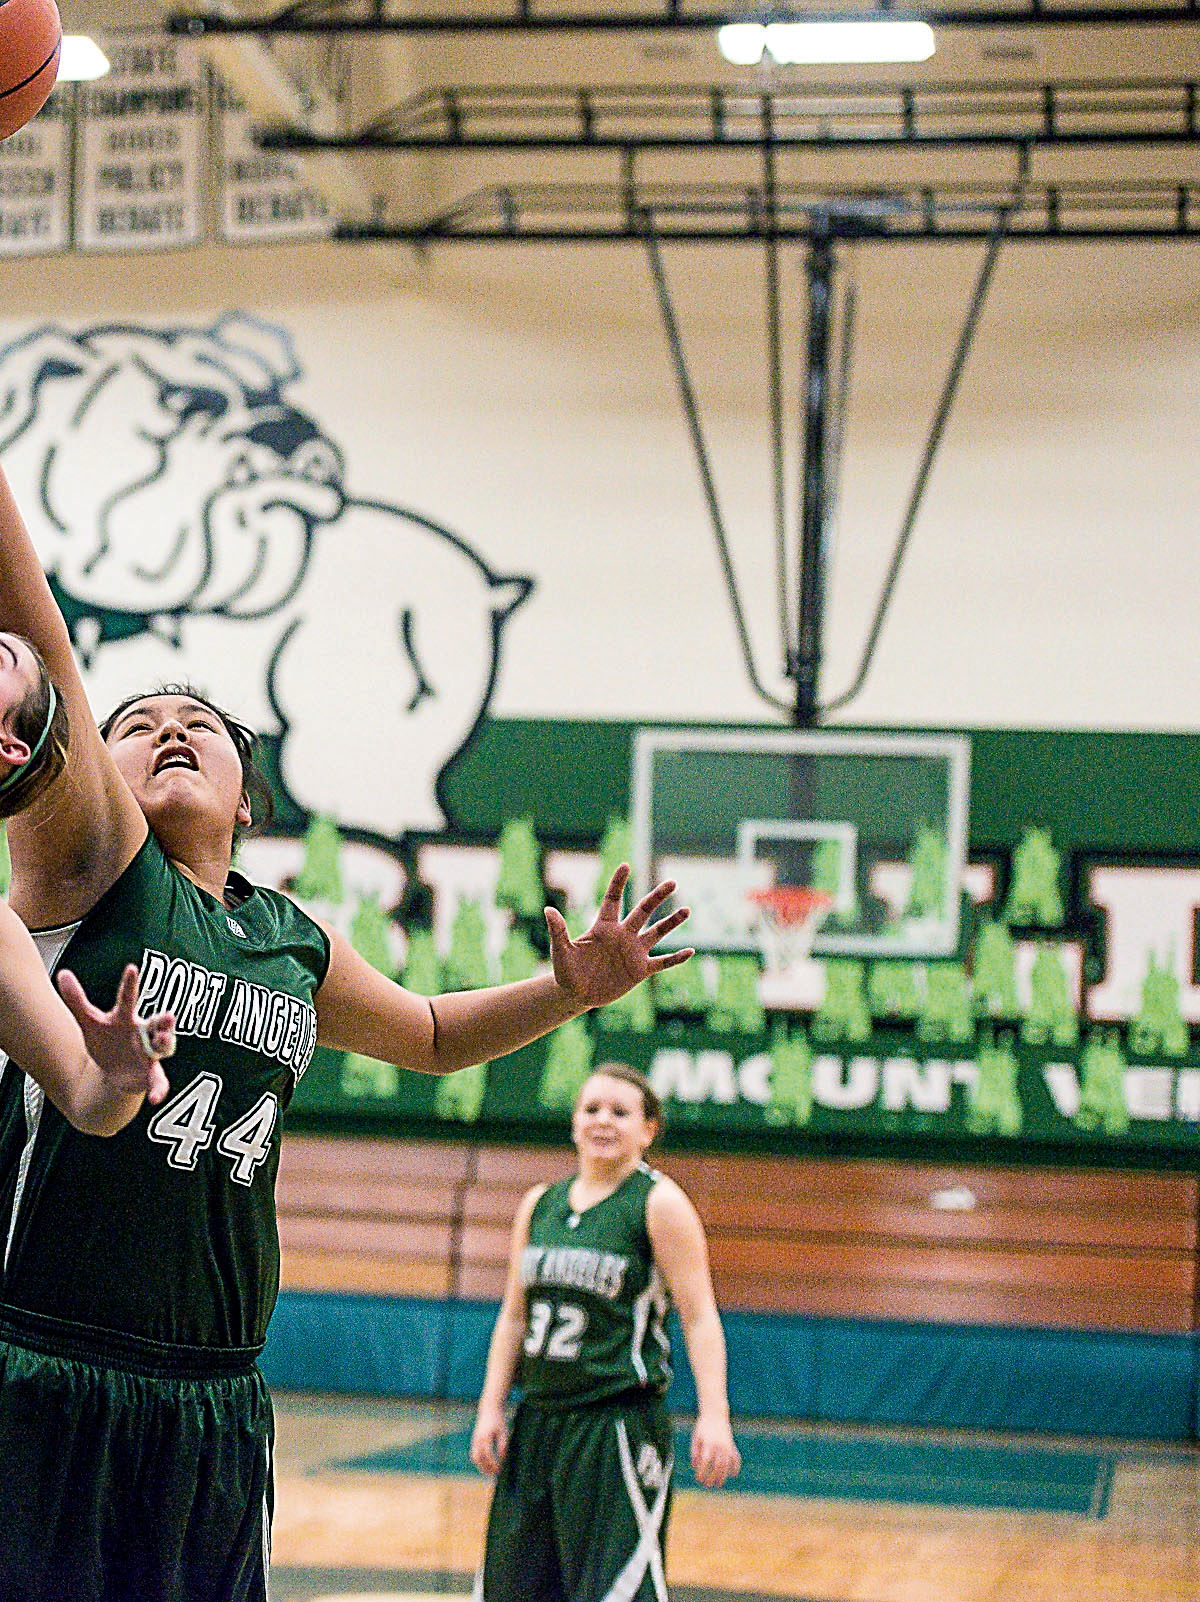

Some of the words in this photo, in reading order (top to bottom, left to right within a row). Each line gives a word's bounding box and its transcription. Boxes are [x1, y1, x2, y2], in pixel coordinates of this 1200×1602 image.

[137, 948, 228, 1039] PORT
[147, 1070, 278, 1188] 44
[523, 1301, 587, 1360] 32
